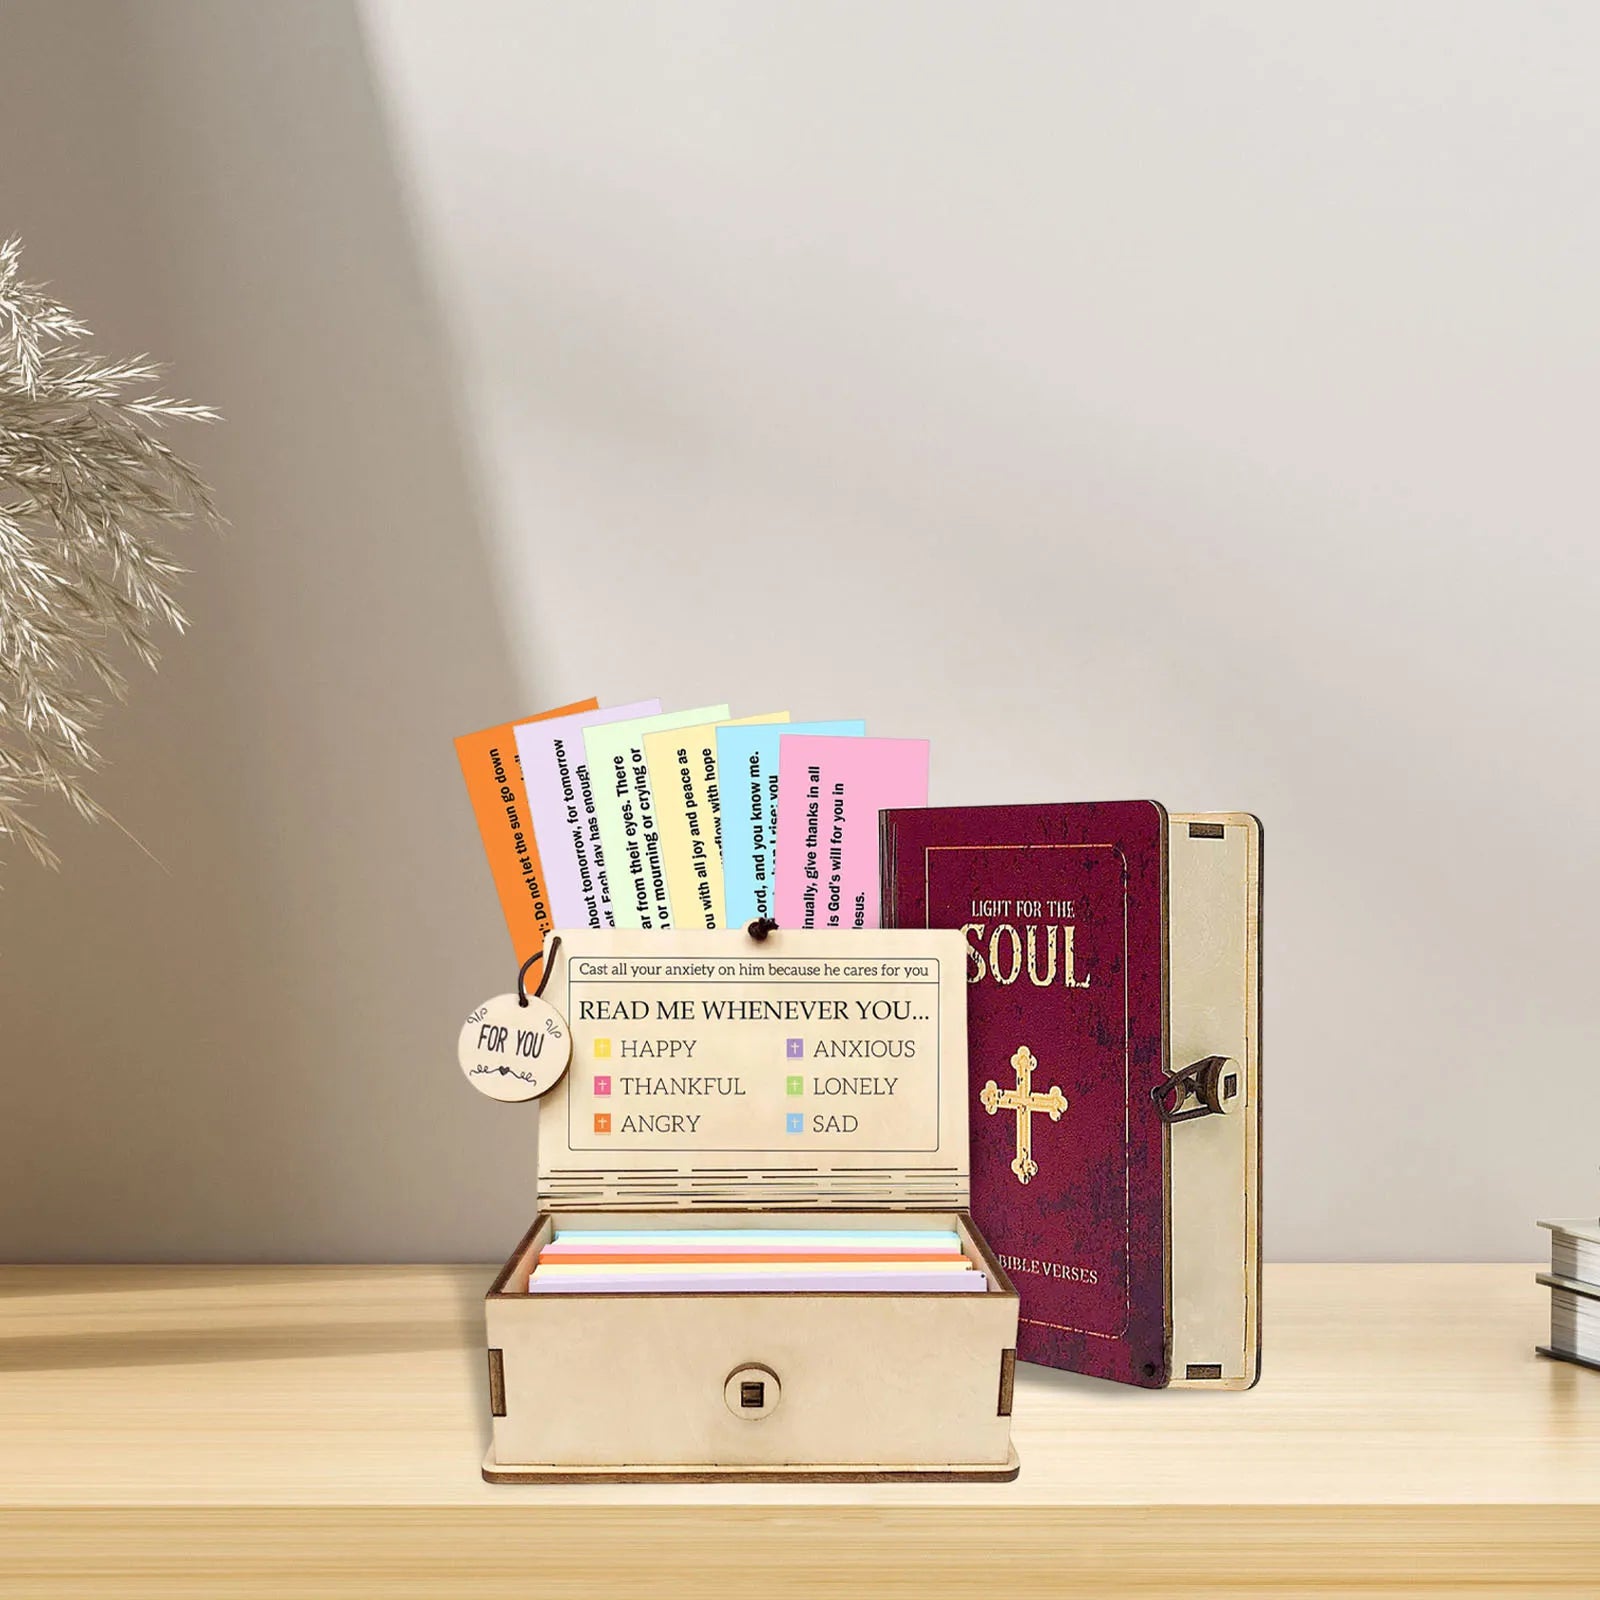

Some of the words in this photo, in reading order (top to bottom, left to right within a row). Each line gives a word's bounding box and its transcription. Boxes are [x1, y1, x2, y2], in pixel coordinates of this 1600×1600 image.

[489, 748, 507, 783] down
[630, 748, 642, 763] or
[677, 748, 688, 764] as
[702, 748, 716, 781] hope
[749, 751, 760, 778] me.
[554, 739, 575, 802] tomorrow
[613, 755, 629, 798] There
[808, 766, 820, 783] all
[500, 786, 515, 803] go
[576, 765, 595, 814] enough
[632, 765, 651, 811] crying
[680, 768, 698, 808] peace
[707, 784, 721, 813] with
[806, 786, 819, 798] in
[832, 783, 844, 795] in
[750, 782, 762, 821] know
[834, 799, 845, 822] you
[506, 806, 521, 830] sun
[567, 805, 579, 824] for
[622, 800, 638, 836] eyes.
[642, 815, 653, 829] or
[685, 811, 700, 836] and
[805, 802, 819, 848] thanks
[588, 817, 600, 842] has
[753, 825, 767, 850] you
[830, 825, 842, 844] for
[514, 832, 528, 855] the
[692, 840, 707, 859] joy
[519, 856, 534, 875] let
[572, 826, 593, 893] tomorrow,
[626, 841, 643, 875] their
[644, 832, 666, 902] mourning
[694, 862, 707, 878] all
[752, 854, 766, 881] and
[804, 851, 819, 880] give
[829, 847, 842, 871] will
[525, 876, 541, 899] not
[636, 878, 649, 912] from
[698, 882, 712, 911] with
[828, 874, 840, 912] God's
[534, 901, 547, 920] Do
[657, 905, 669, 920] or
[802, 883, 818, 929] inually,
[971, 900, 1012, 918] LIGHT
[1016, 900, 1042, 918] FOR
[1047, 900, 1076, 918] THE
[827, 915, 840, 927] is
[960, 923, 1091, 988] SOUL
[579, 962, 609, 976] Cast
[611, 962, 628, 976] all
[630, 965, 663, 980] your
[665, 963, 715, 980] anxiety
[718, 966, 736, 976] on
[739, 963, 765, 976] him
[768, 963, 821, 977] because
[823, 963, 841, 977] he
[843, 966, 878, 977] cares
[881, 963, 900, 977] for
[904, 966, 929, 980] you
[578, 1000, 650, 1021] READ
[656, 1000, 695, 1021] ME
[702, 1000, 850, 1021] WHENEVER
[856, 1000, 929, 1021] YOU...
[477, 1024, 509, 1053] FOR
[516, 1029, 545, 1059] YOU
[620, 1039, 697, 1058] HAPPY
[813, 1039, 916, 1058] ANXIOUS
[620, 1077, 746, 1096] THANKFUL
[813, 1077, 899, 1096] LONELY
[620, 1115, 701, 1134] ANGRY
[813, 1115, 859, 1134] SAD
[999, 1254, 1040, 1274] BIBLE
[1042, 1262, 1098, 1285] VERSES
